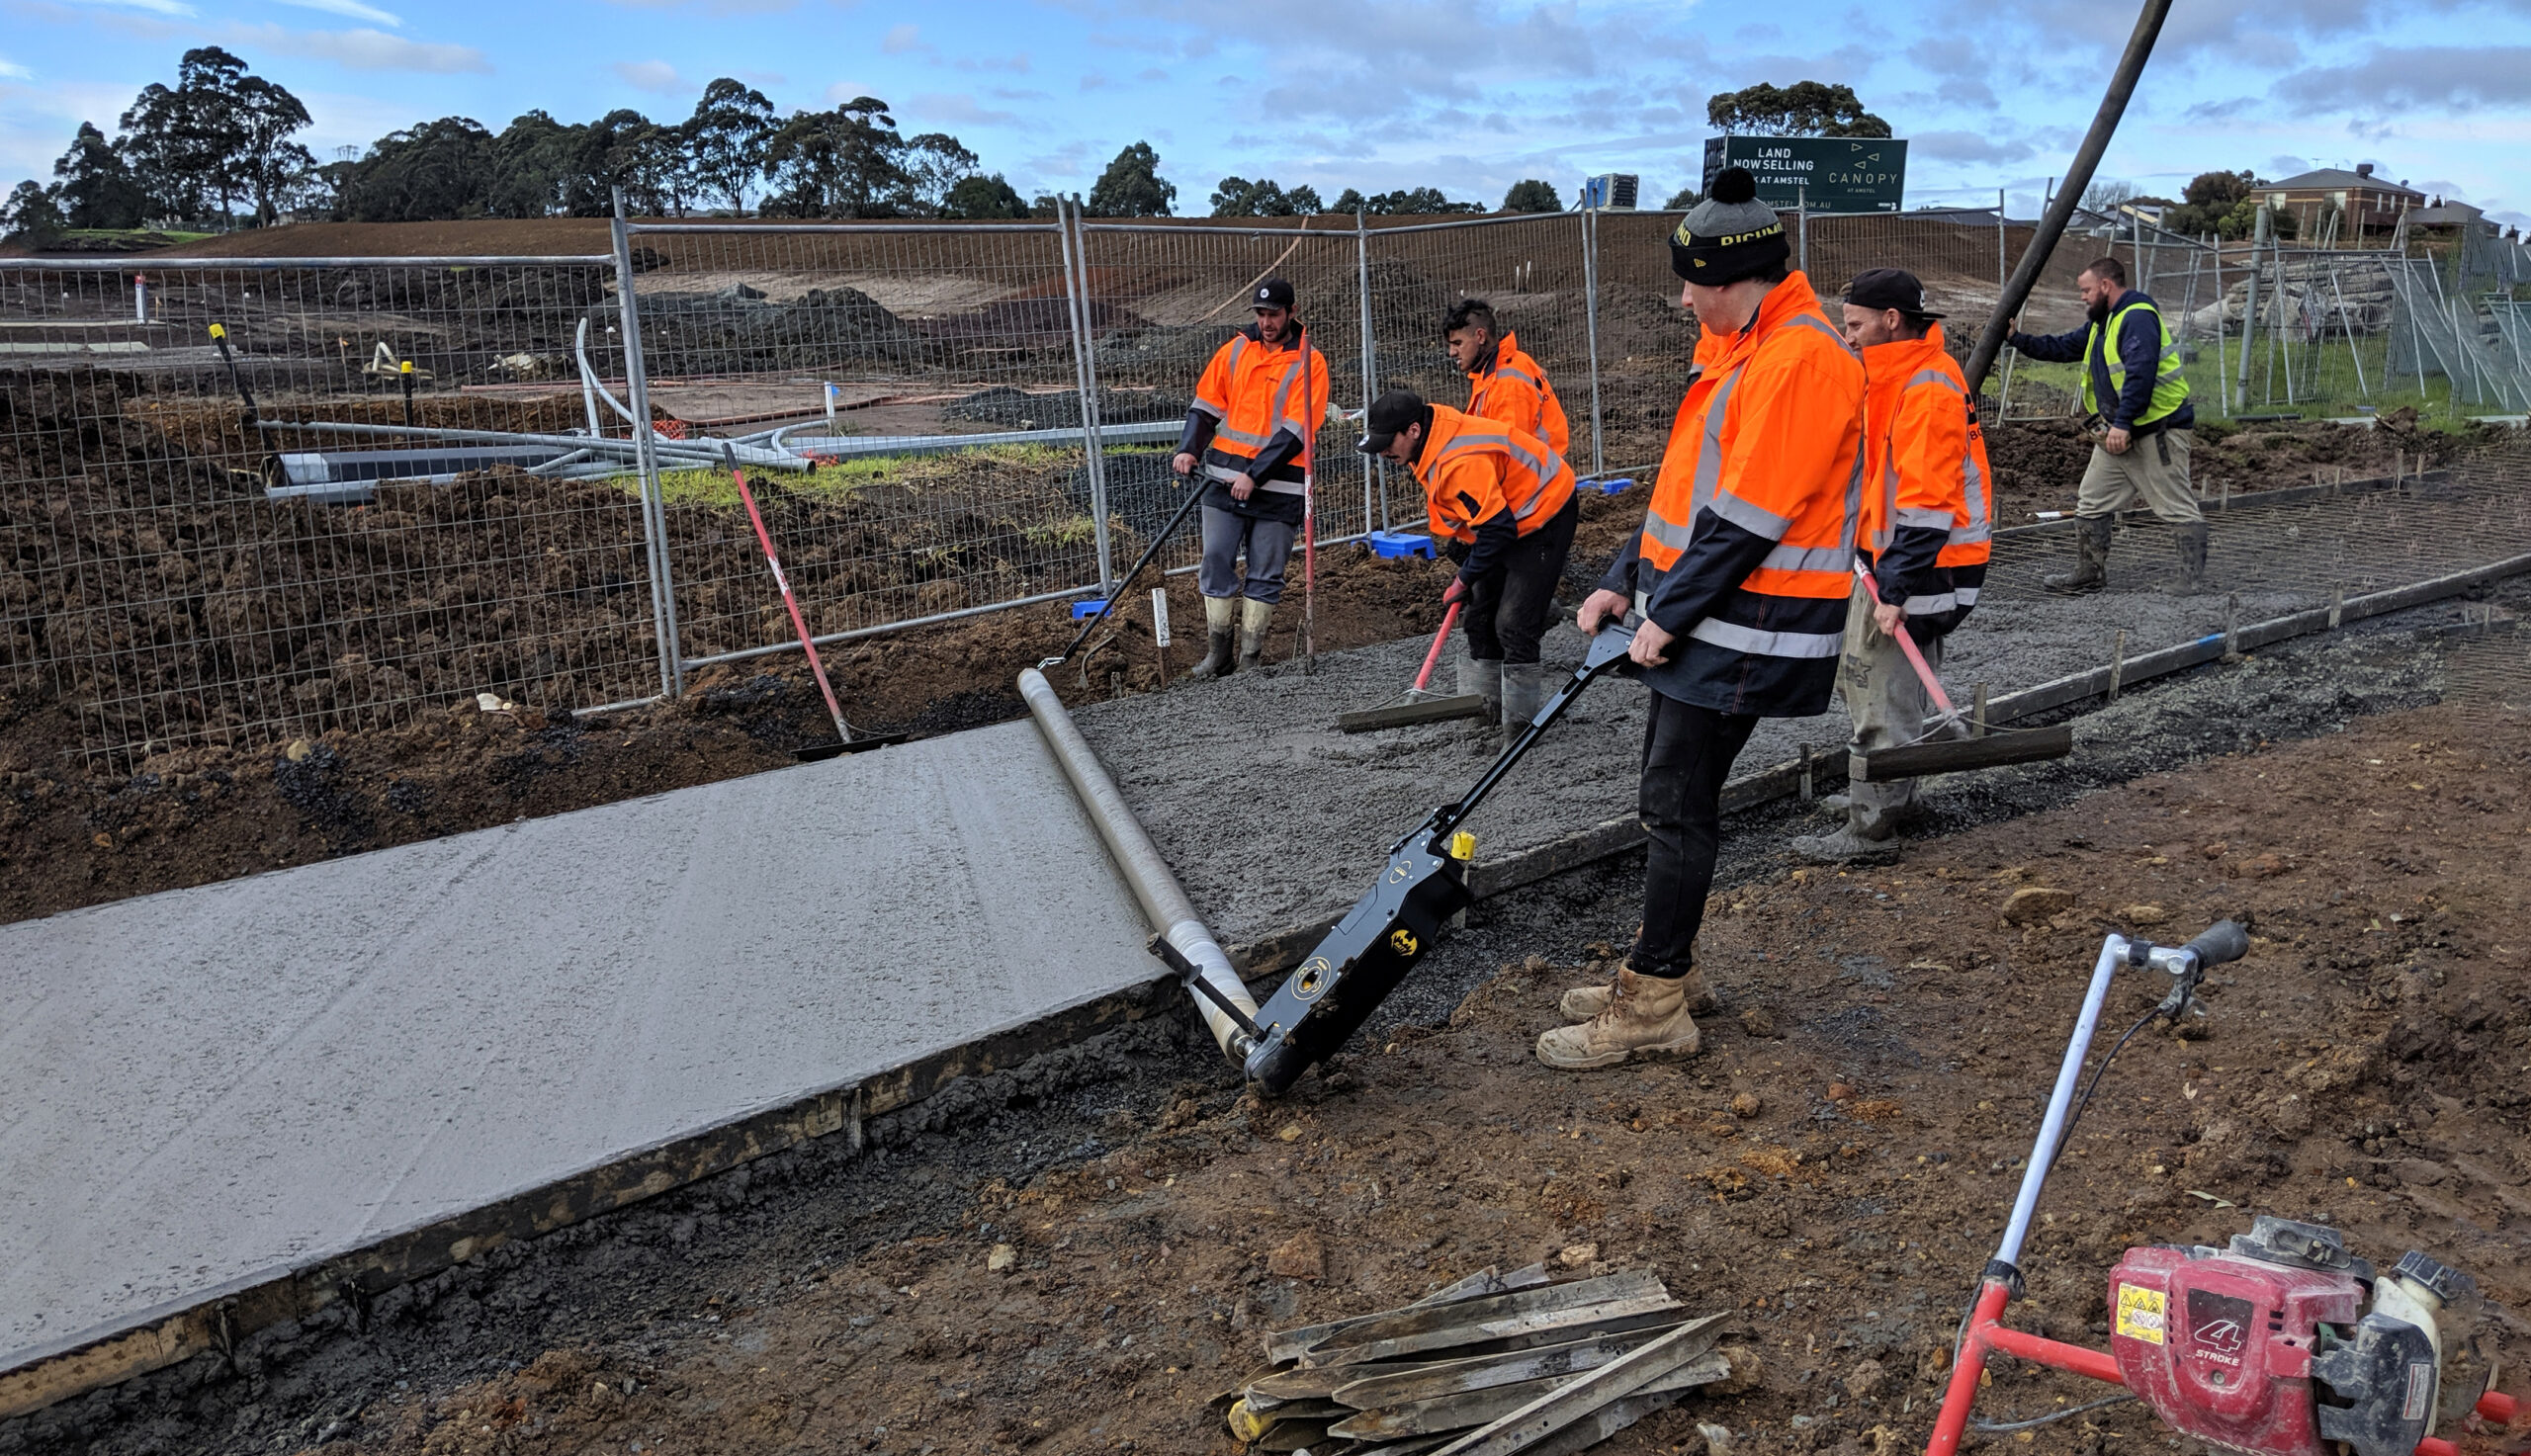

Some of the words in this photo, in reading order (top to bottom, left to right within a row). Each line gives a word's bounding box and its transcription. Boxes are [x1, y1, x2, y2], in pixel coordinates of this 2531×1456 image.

[1758, 147, 1791, 158] LAND
[1733, 159, 1760, 169] NOW
[1763, 160, 1814, 171] SELLING
[1760, 176, 1772, 185] AT
[1828, 172, 1897, 185] CANOPY
[2195, 1319, 2242, 1353] 4
[2195, 1348, 2240, 1367] STROKE
